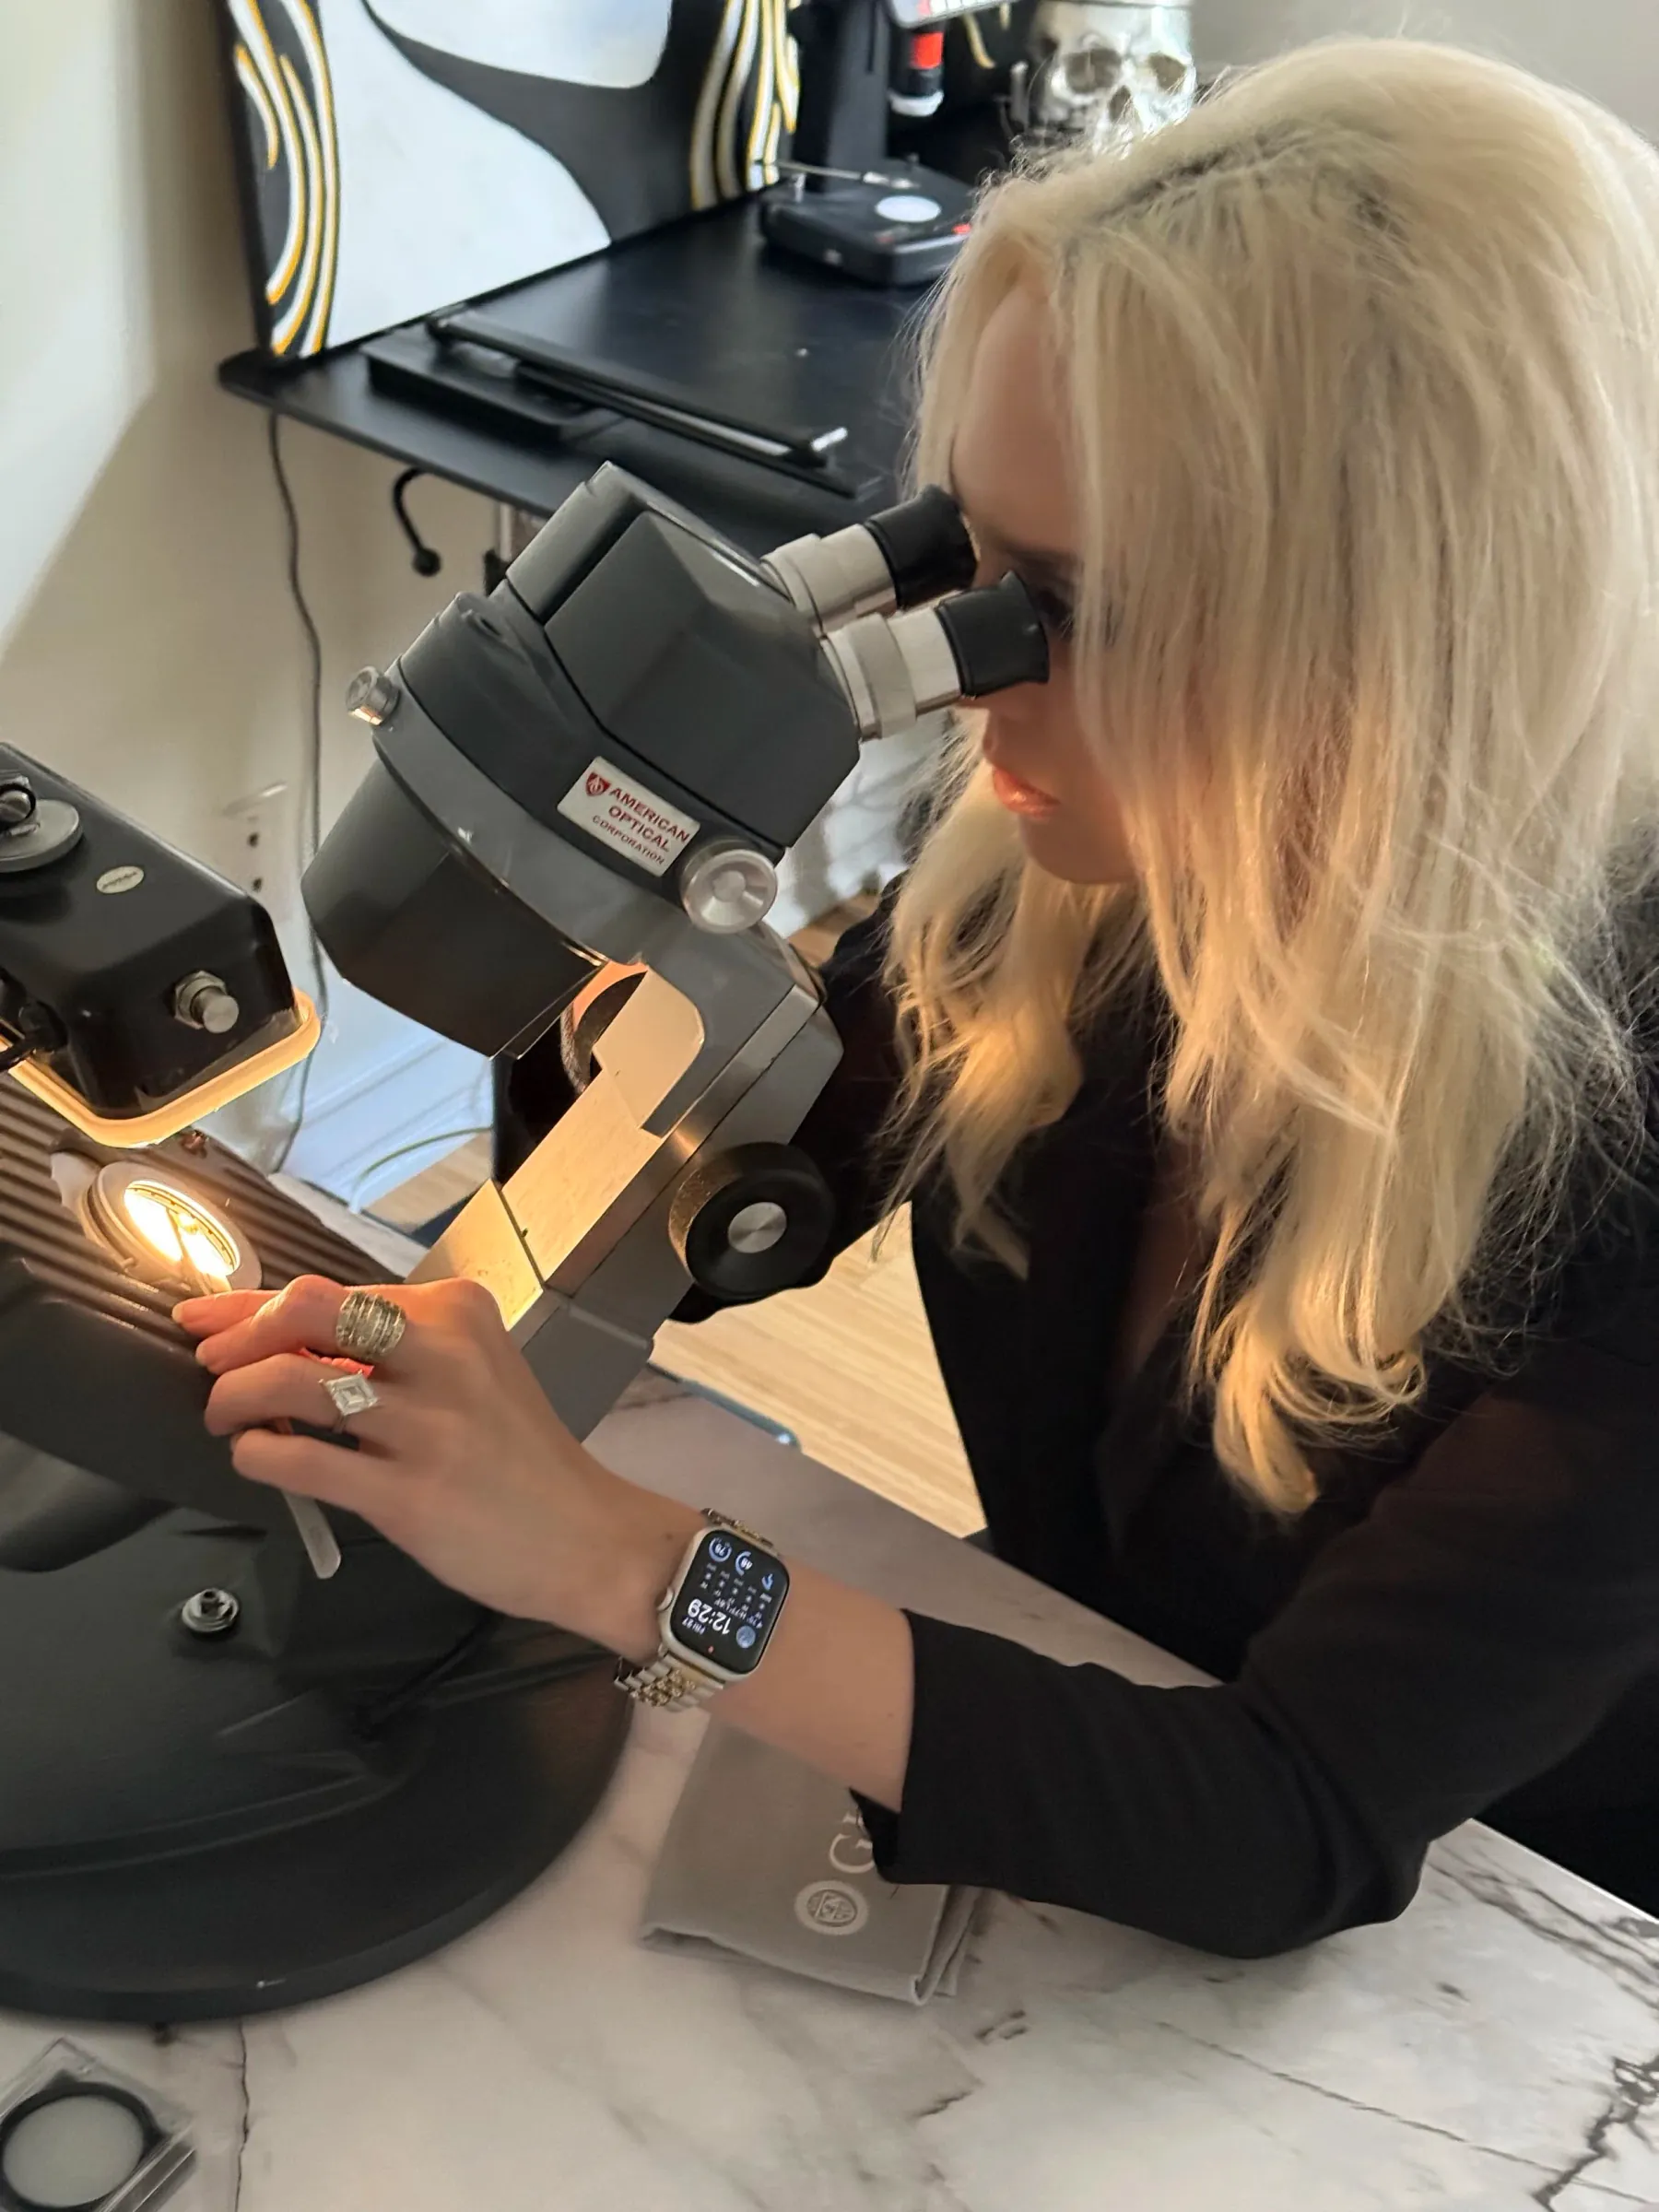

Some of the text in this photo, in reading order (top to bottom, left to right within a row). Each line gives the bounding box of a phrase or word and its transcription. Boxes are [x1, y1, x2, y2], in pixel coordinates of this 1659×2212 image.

[608, 806, 669, 852] OPTICAL
[609, 788, 689, 842] AMERICAN
[593, 815, 664, 865] CORPORATION
[688, 1598, 730, 1635] 12:29
